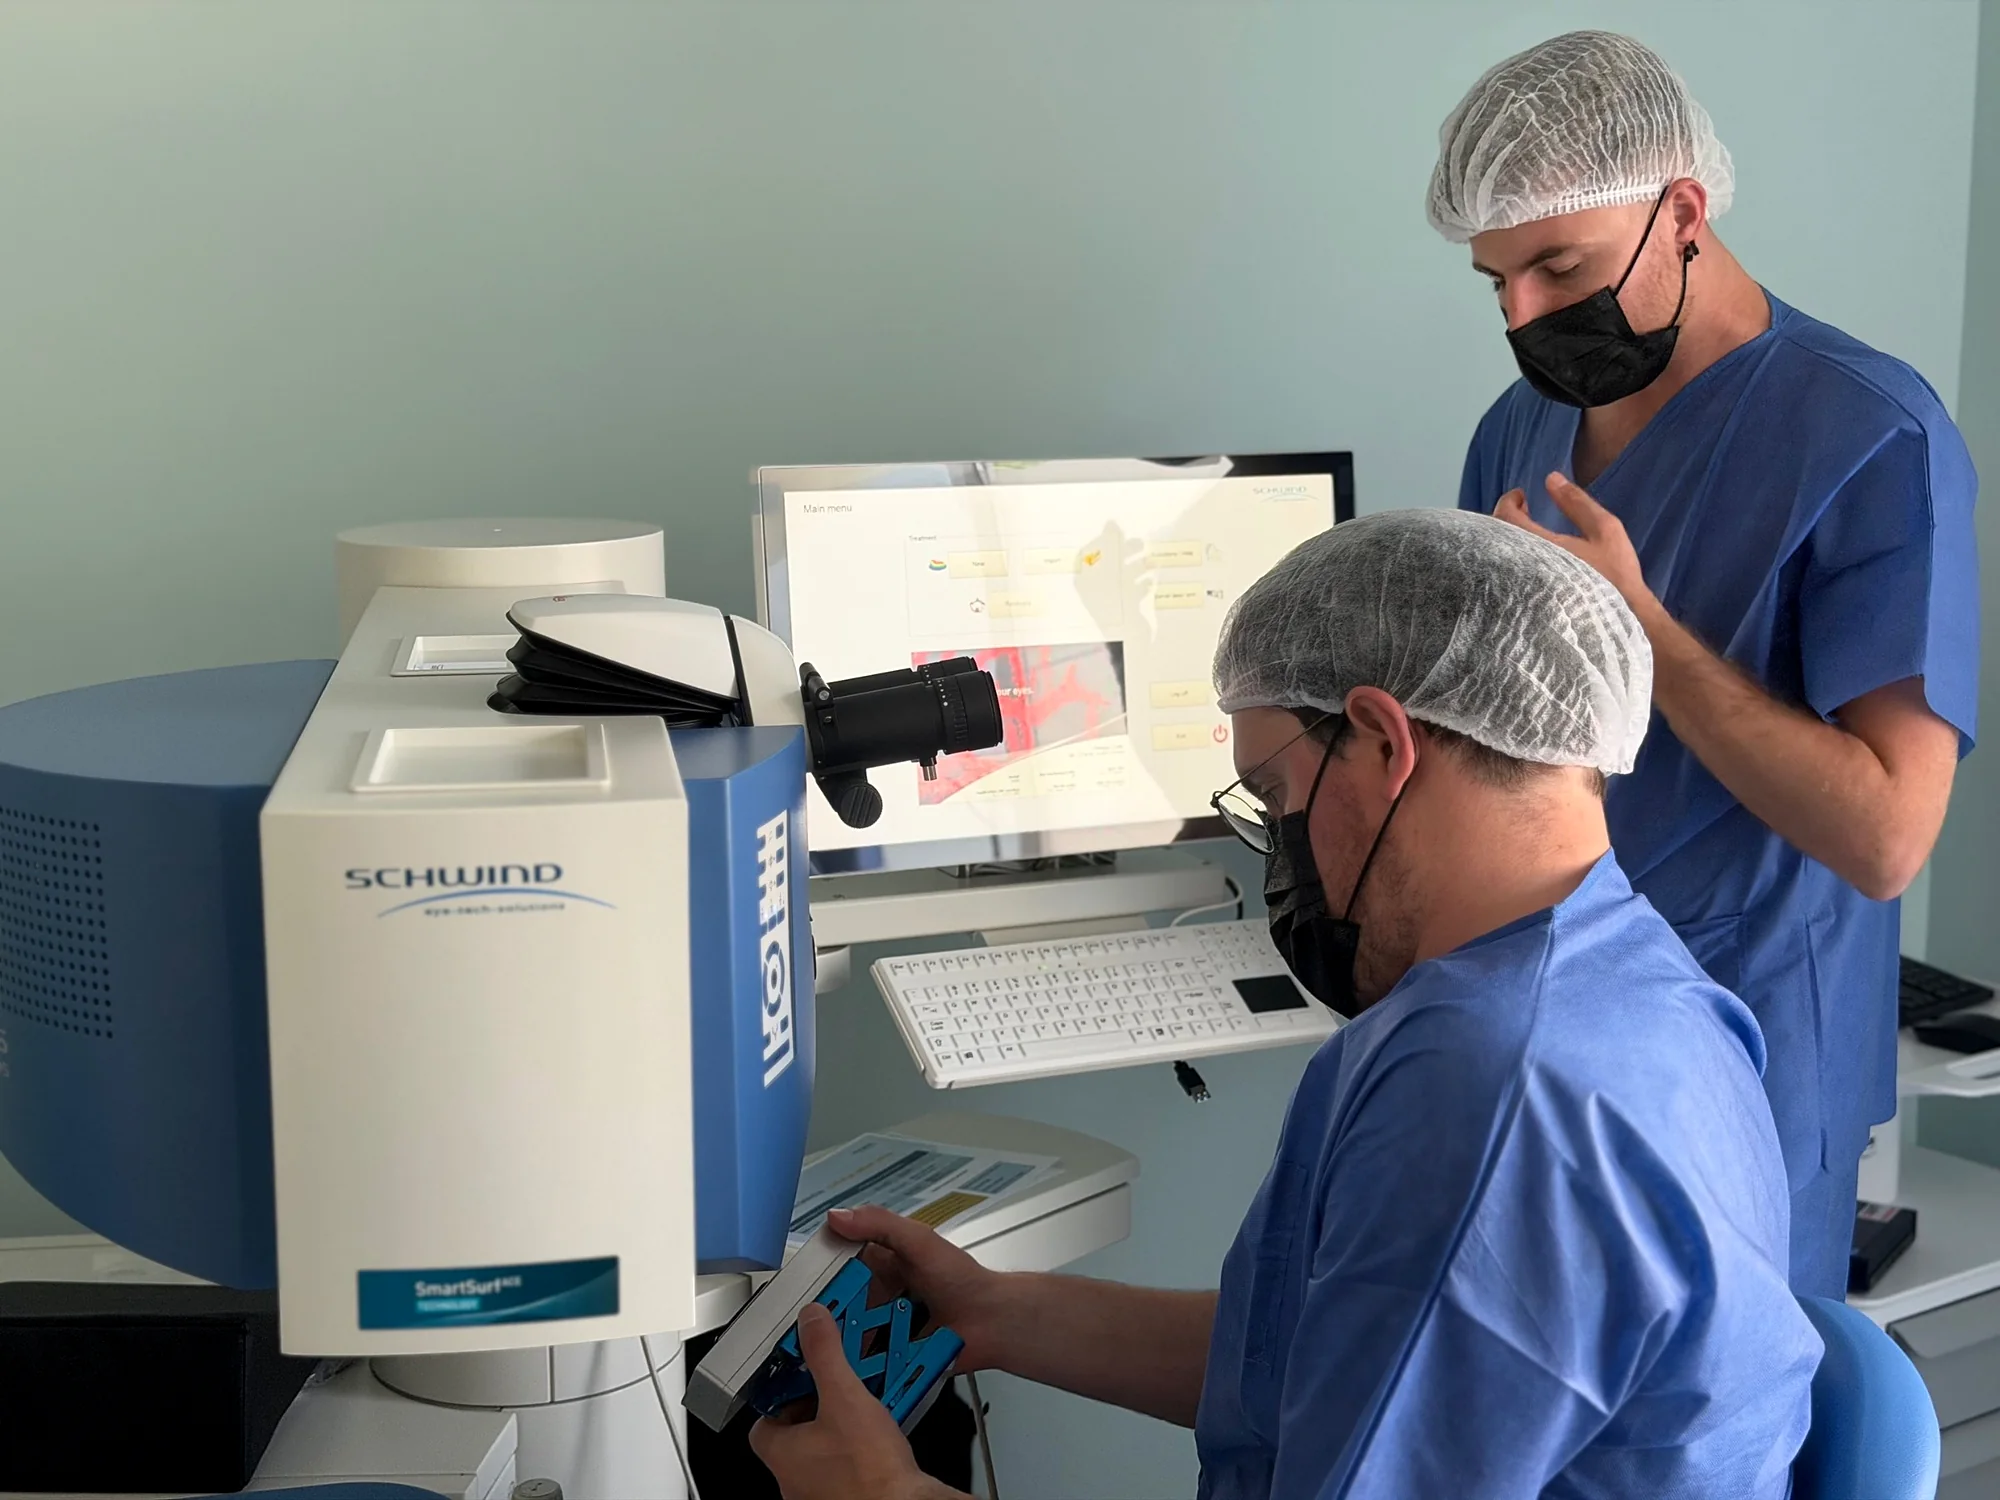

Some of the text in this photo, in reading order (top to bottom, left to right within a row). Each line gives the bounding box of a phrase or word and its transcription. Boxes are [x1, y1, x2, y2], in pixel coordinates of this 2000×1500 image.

[803, 504, 853, 514] Main menu
[1012, 686, 1034, 698] eyes.
[345, 863, 564, 890] SCHWIND
[424, 902, 566, 917] eye-tech-solutions
